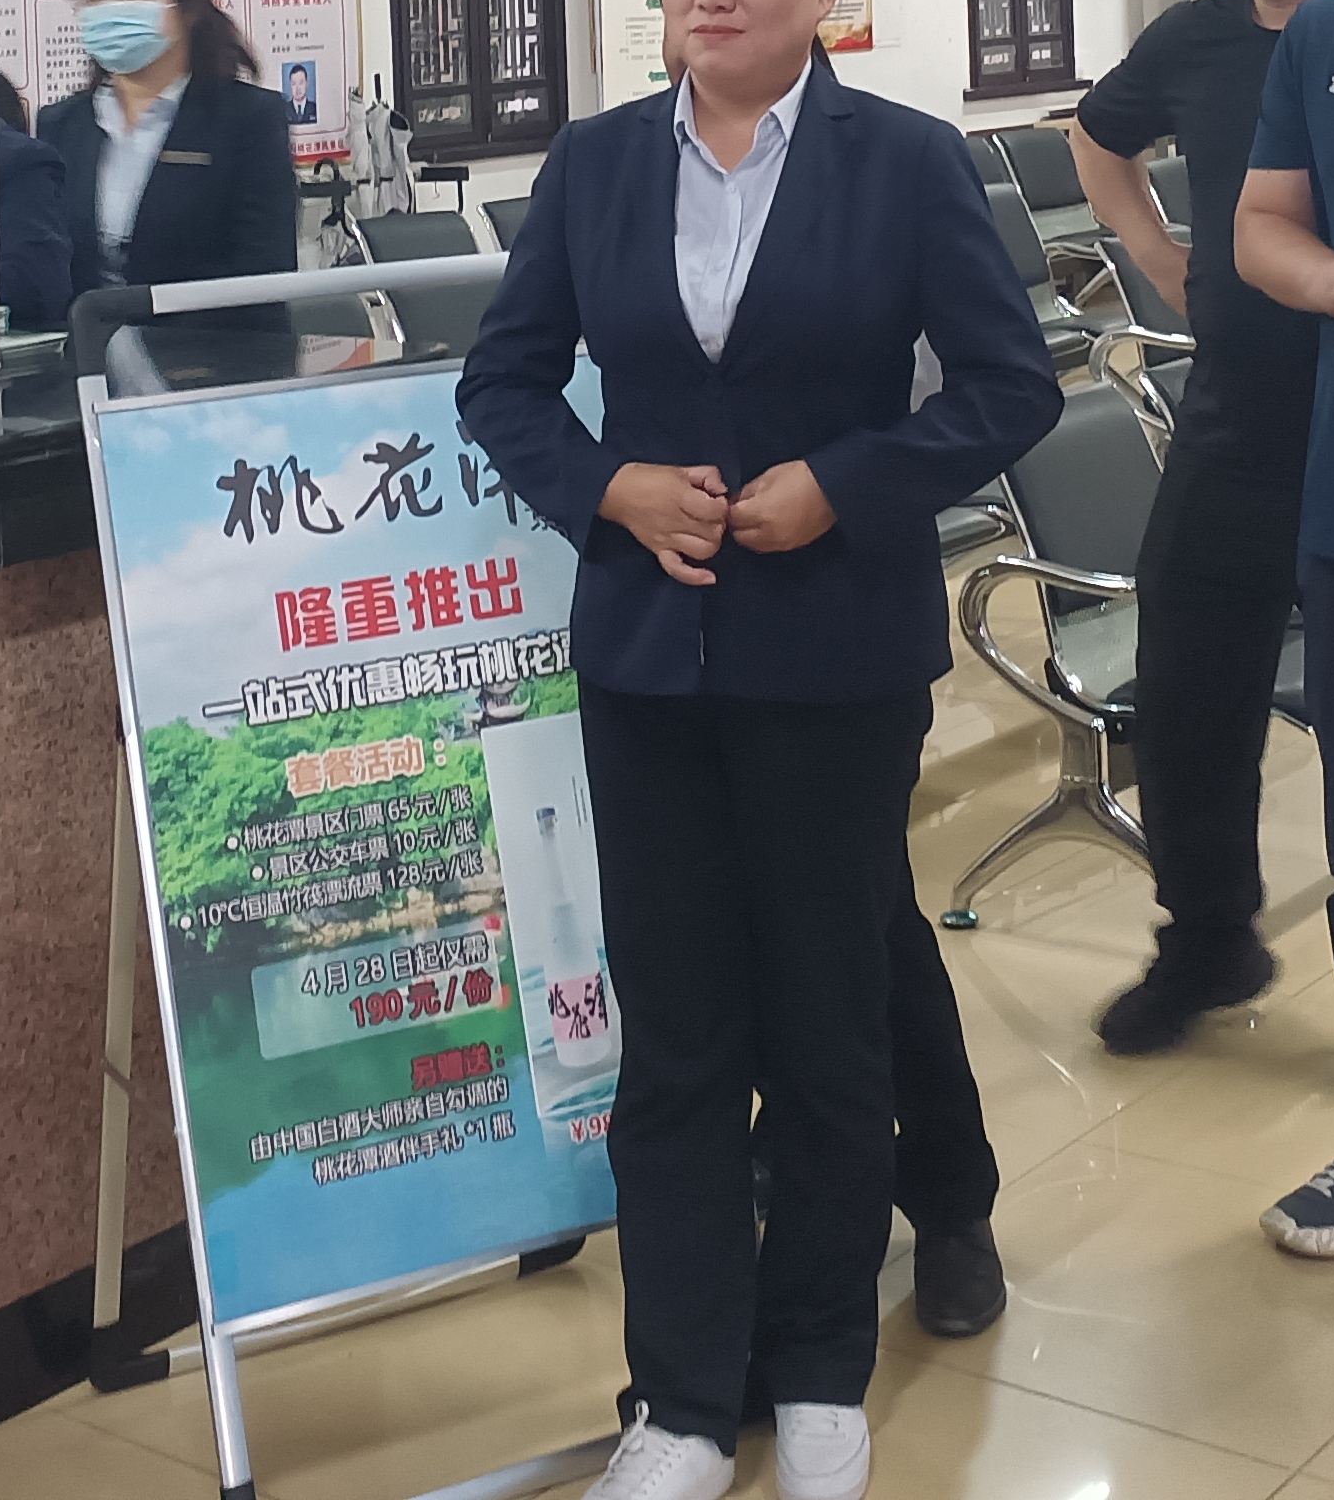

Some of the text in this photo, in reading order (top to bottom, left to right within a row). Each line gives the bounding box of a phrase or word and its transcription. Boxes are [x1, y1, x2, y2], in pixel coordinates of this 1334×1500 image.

[274, 556, 524, 653] 隆重推出
[286, 736, 448, 797] 套餐活动：
[350, 966, 495, 1028] 190元/份
